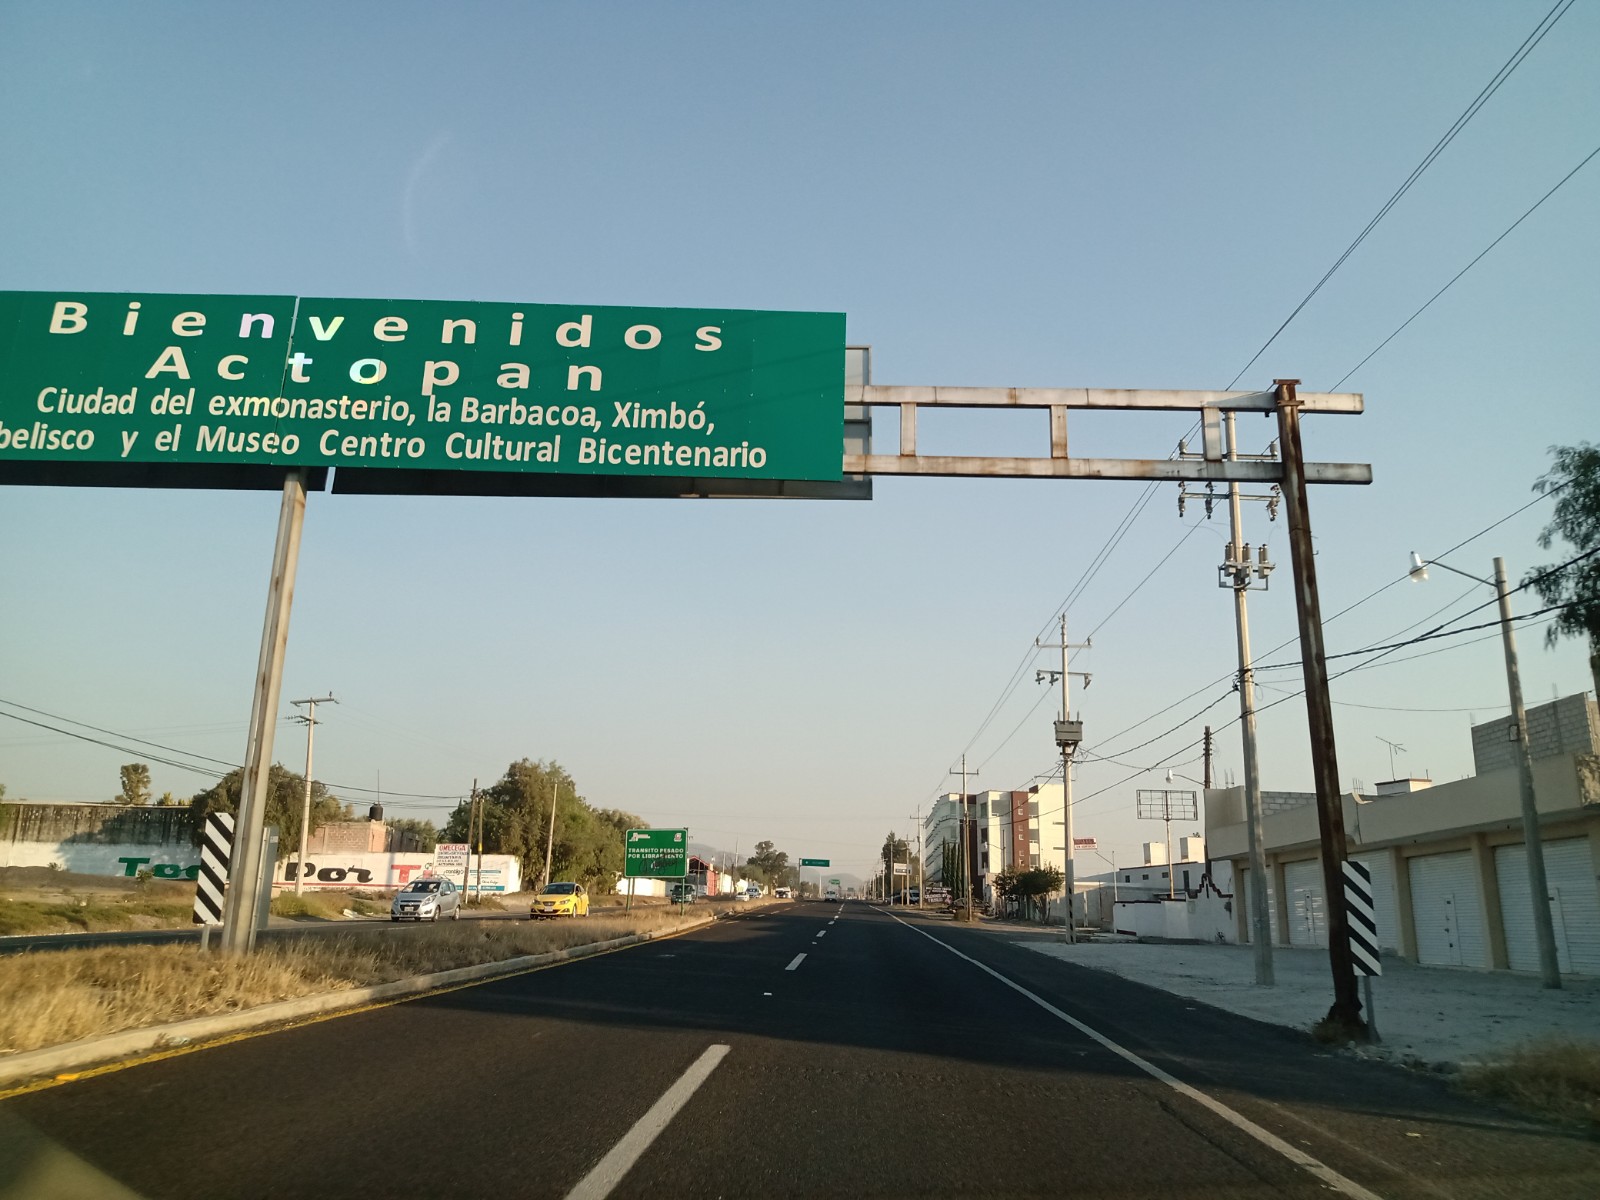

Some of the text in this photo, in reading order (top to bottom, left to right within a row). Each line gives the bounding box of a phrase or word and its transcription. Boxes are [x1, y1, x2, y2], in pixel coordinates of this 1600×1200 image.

[50, 302, 722, 351] Bienvenidos
[145, 347, 603, 396] Actopan
[37, 386, 715, 436] Ciudad del exmonasterio, la Barbacoa, Ximbó,
[121, 430, 139, 458] y
[155, 424, 182, 452] el
[195, 425, 300, 455] Museo
[319, 429, 426, 458] Centro
[445, 432, 561, 463] Cultural
[578, 437, 767, 468] Bicentenario
[284, 862, 373, 883] Por
